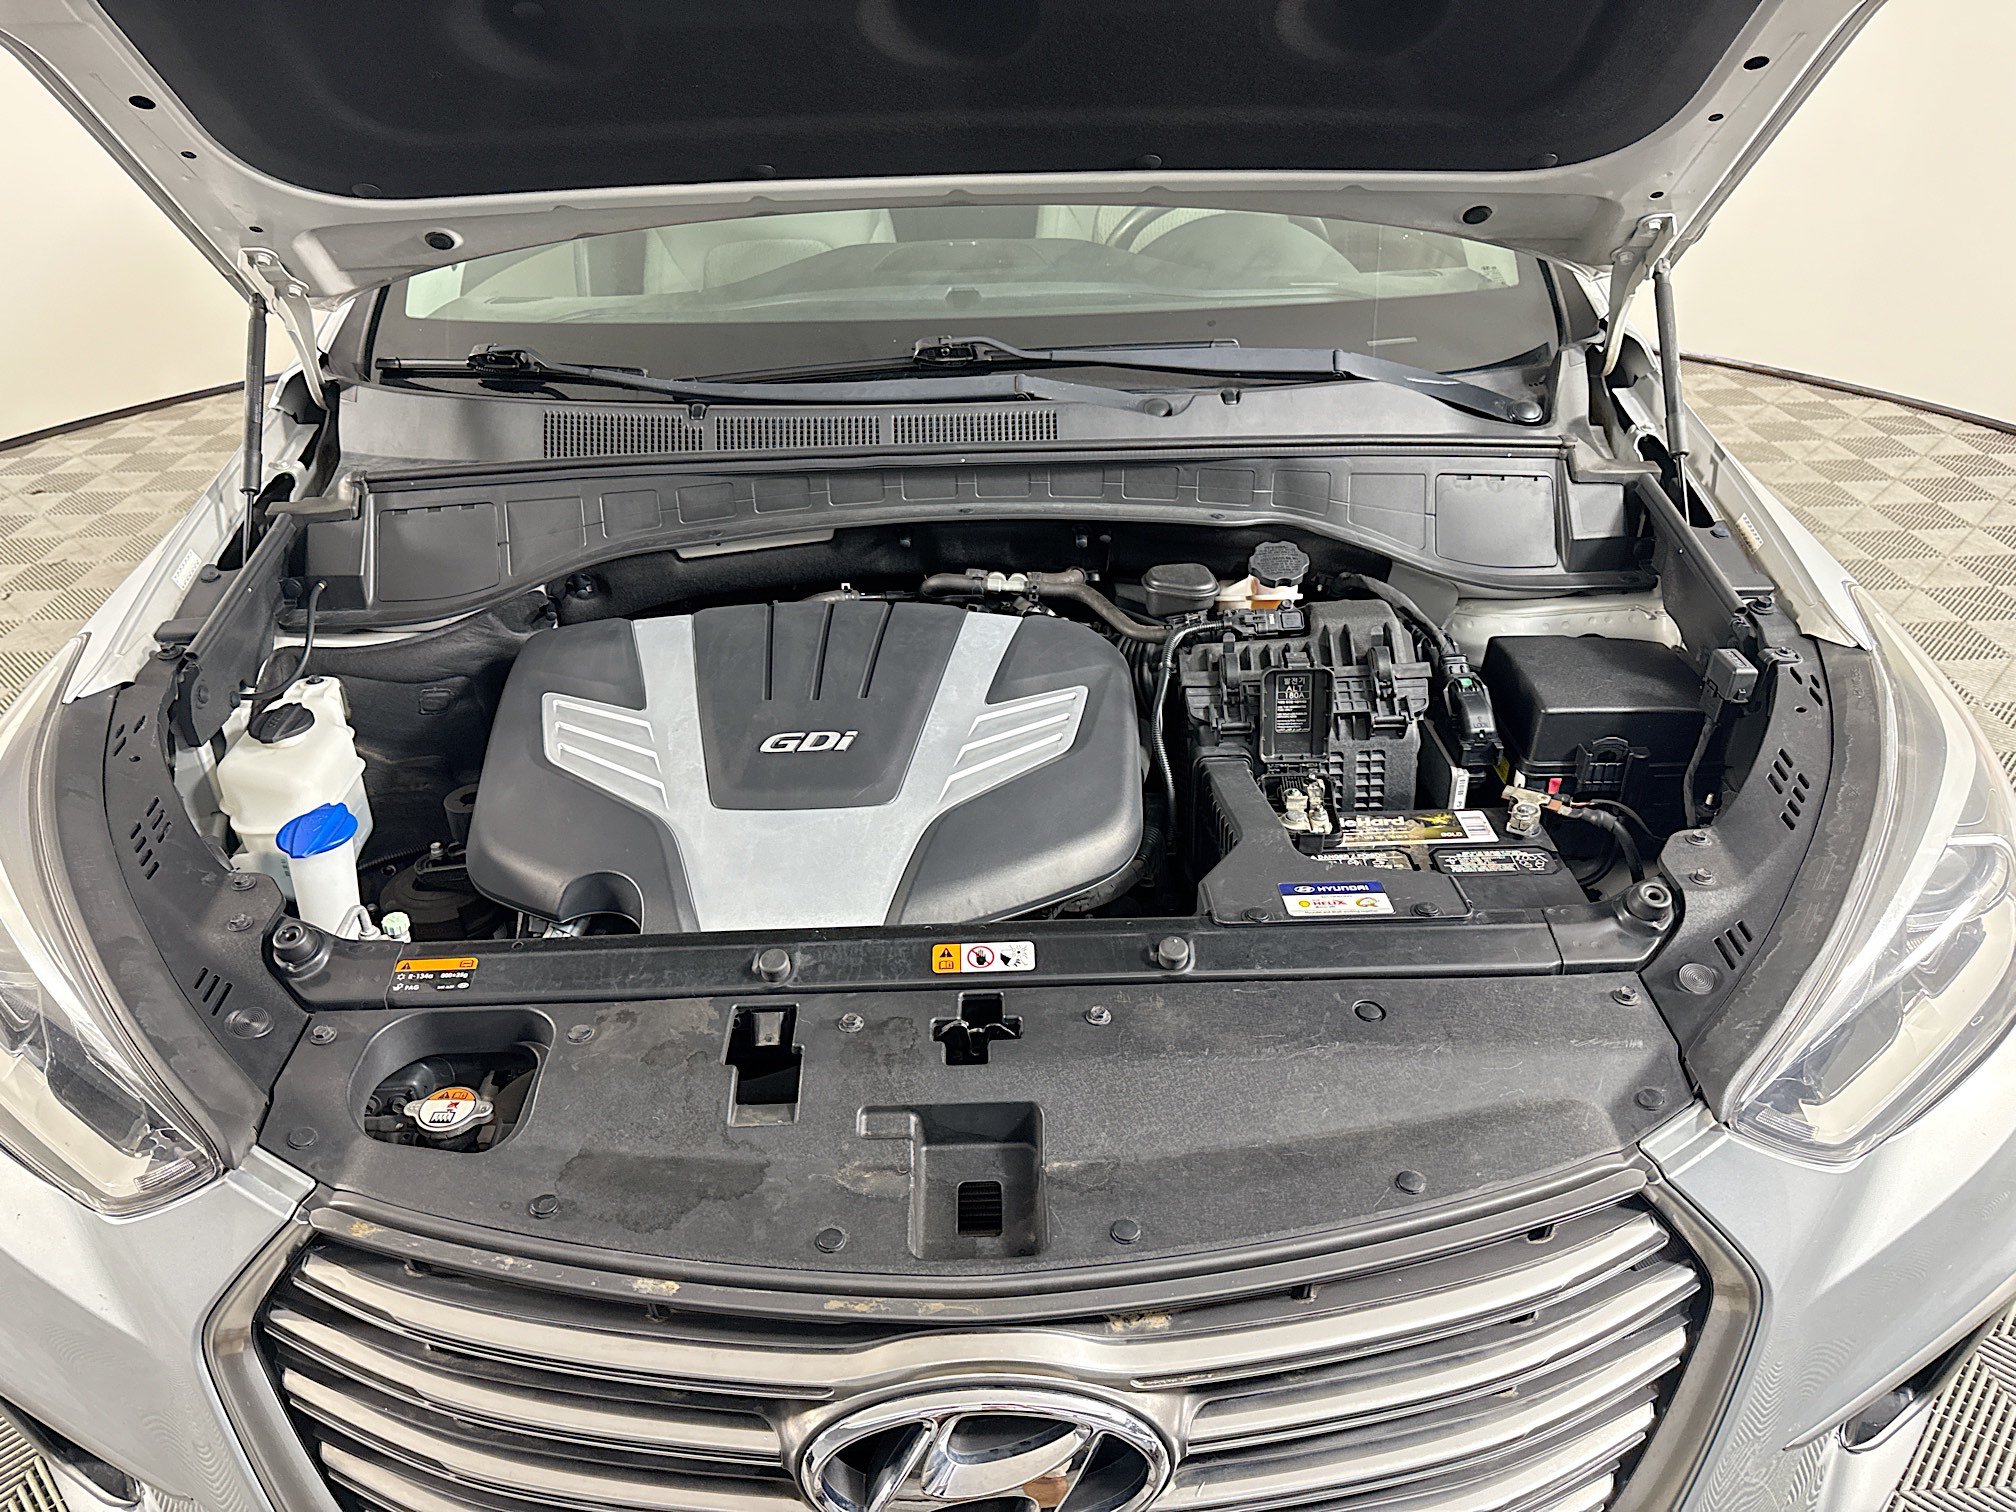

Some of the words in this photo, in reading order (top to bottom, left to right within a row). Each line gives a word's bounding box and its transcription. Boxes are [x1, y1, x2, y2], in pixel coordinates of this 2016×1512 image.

[1283, 677, 1306, 685] 발전기
[759, 730, 859, 753] GDi
[1317, 884, 1370, 892] HYUNDAI
